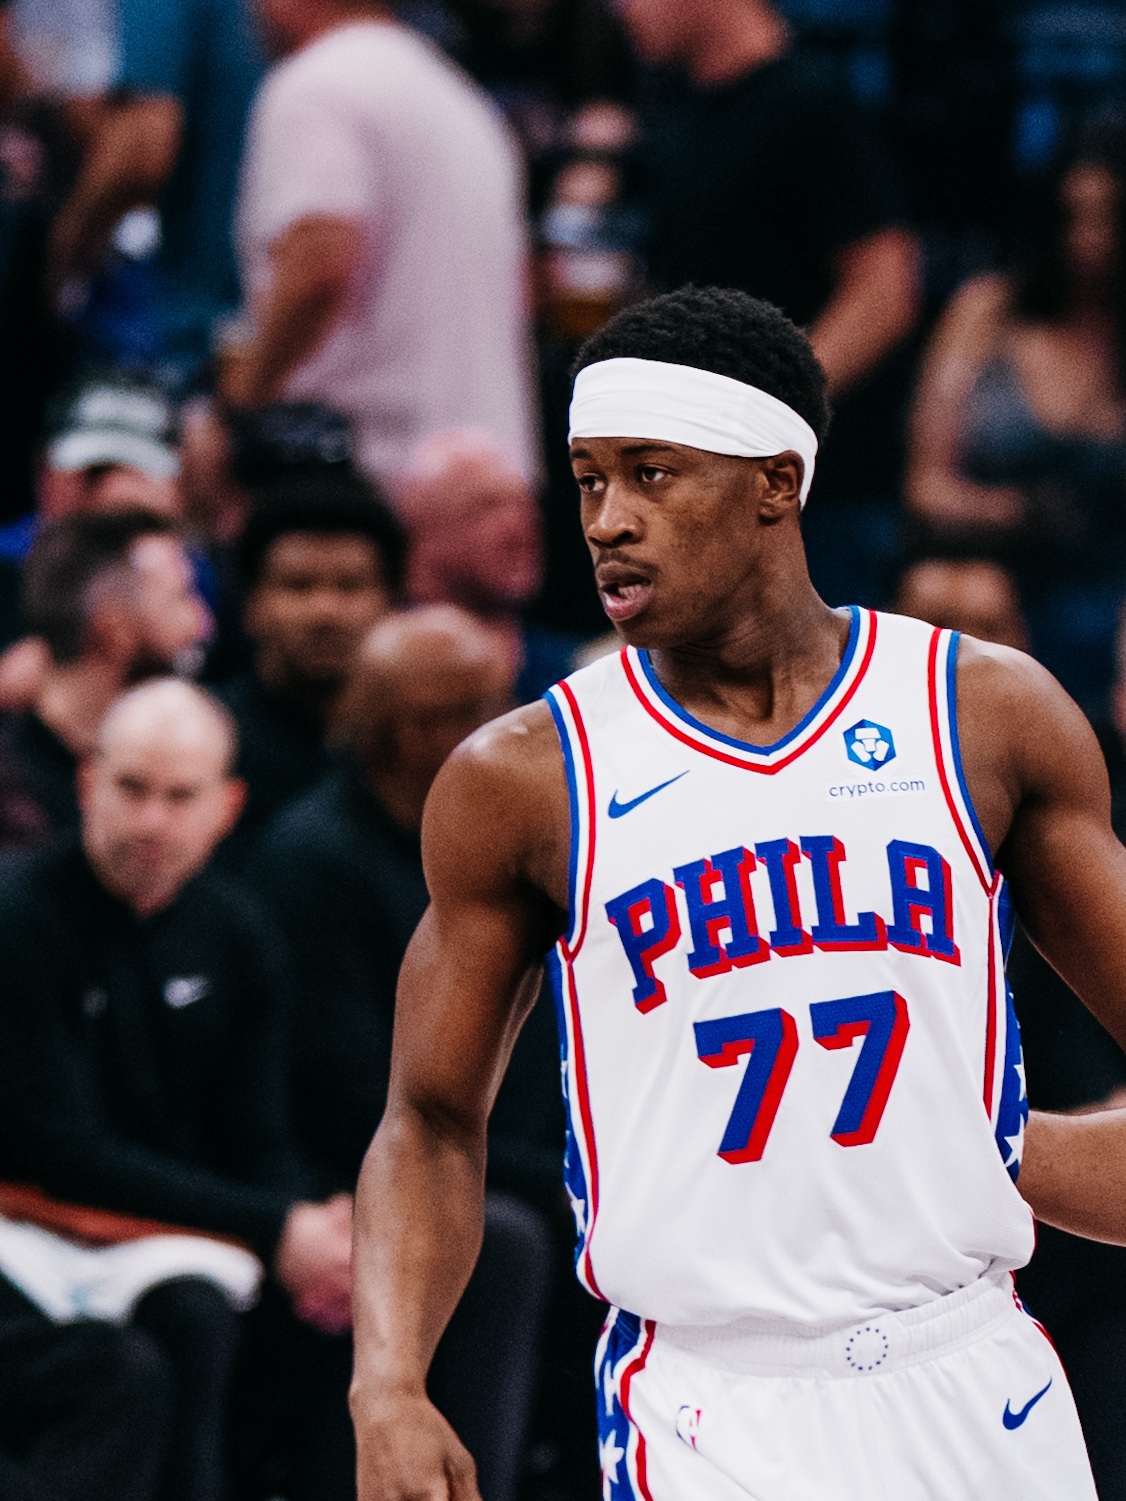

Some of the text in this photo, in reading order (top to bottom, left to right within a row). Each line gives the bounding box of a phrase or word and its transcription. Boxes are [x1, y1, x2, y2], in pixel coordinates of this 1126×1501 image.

[829, 780, 925, 798] crypto.com
[604, 835, 962, 1015] PHILA
[693, 990, 911, 1165] 77
